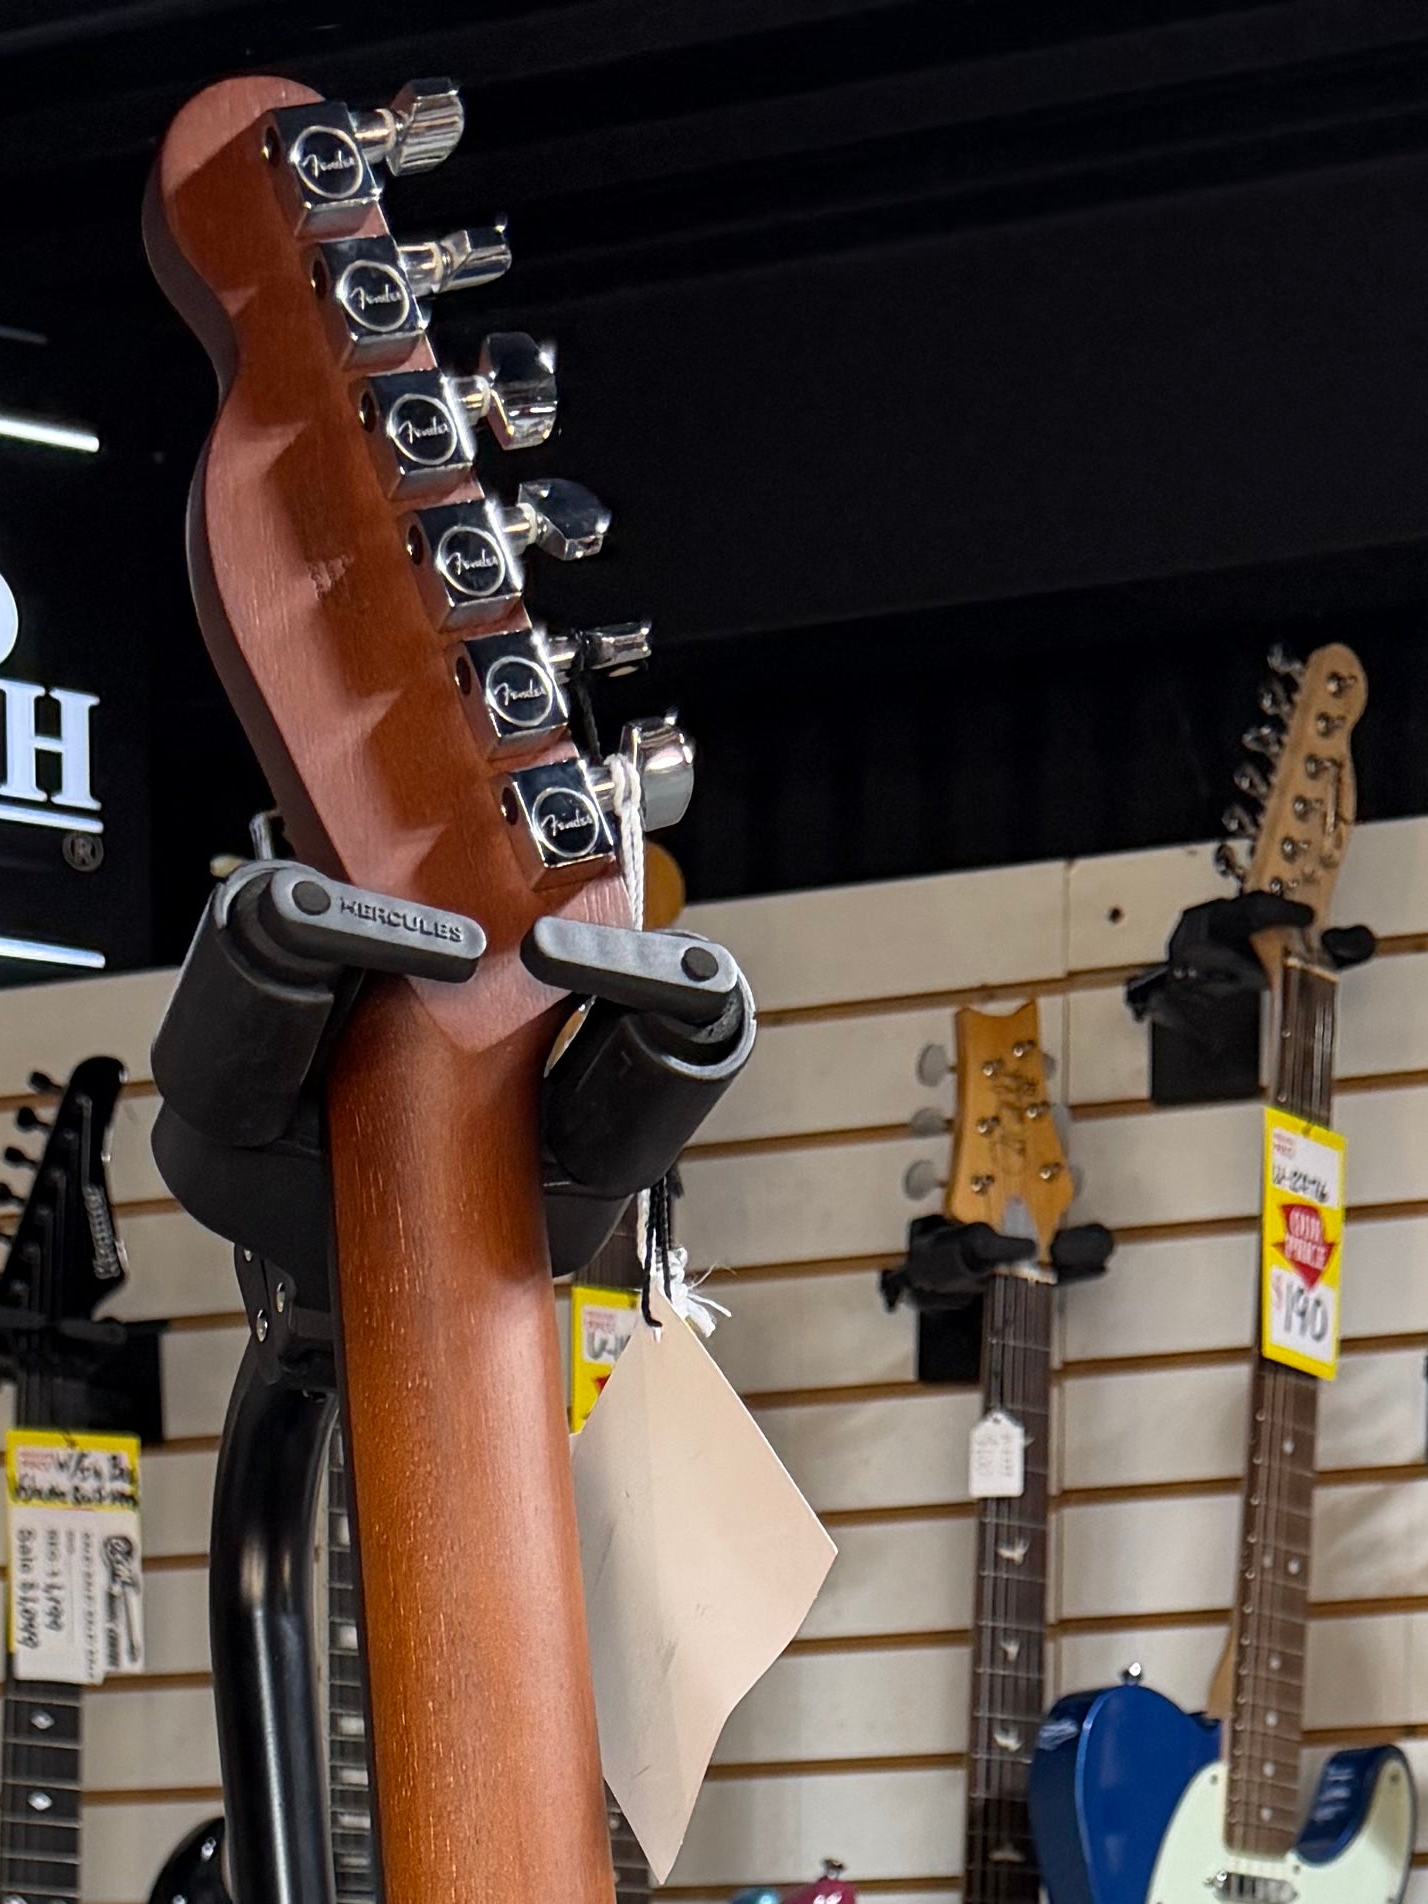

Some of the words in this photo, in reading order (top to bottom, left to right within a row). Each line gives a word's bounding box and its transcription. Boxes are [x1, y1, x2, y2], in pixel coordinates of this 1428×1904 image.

[301, 149, 356, 178] Fender
[348, 284, 404, 311] Fender
[397, 416, 450, 444] Fender
[445, 548, 498, 576] Fender
[493, 678, 547, 706] Fender
[540, 808, 594, 837] Fender
[339, 895, 463, 944] HERCULES
[1288, 1205, 1322, 1240] OUR
[1283, 1230, 1328, 1271] PRICE
